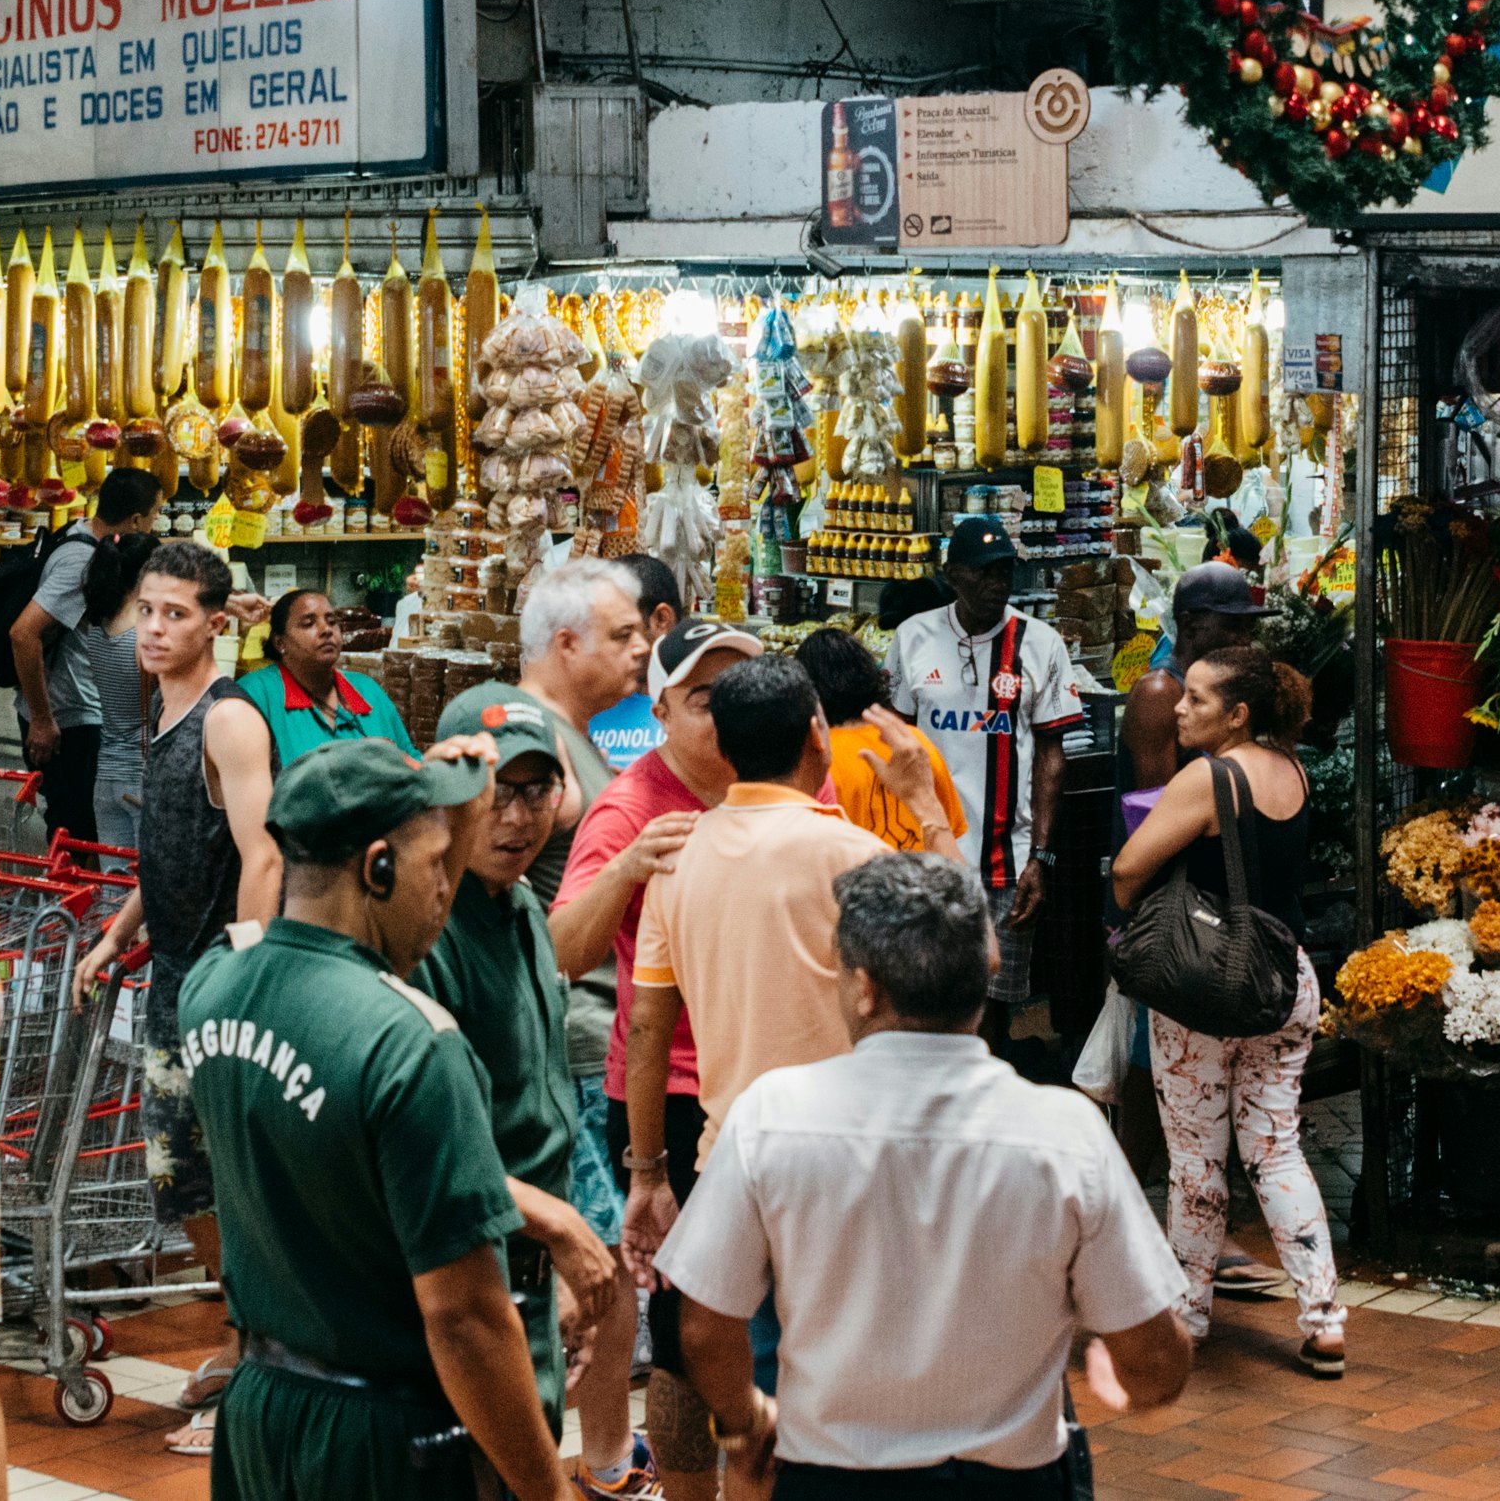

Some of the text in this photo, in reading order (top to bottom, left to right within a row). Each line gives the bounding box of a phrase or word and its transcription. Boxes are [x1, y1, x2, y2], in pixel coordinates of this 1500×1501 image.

[119, 40, 156, 76] EM
[182, 19, 303, 69] QUEIJOS
[43, 96, 57, 128] E
[80, 87, 164, 125] DOCES
[185, 81, 219, 114] EM
[249, 67, 348, 109] GERAL
[917, 105, 990, 117] Praça do Abacaxi
[194, 119, 341, 155] FONE: 274-9711
[917, 128, 954, 138] Elevador
[917, 150, 970, 160] Informações
[1287, 348, 1311, 358] VISA
[1288, 370, 1311, 380] VISA
[930, 708, 1012, 735] CAIXA
[181, 1017, 327, 1123] SEGURANÇA
